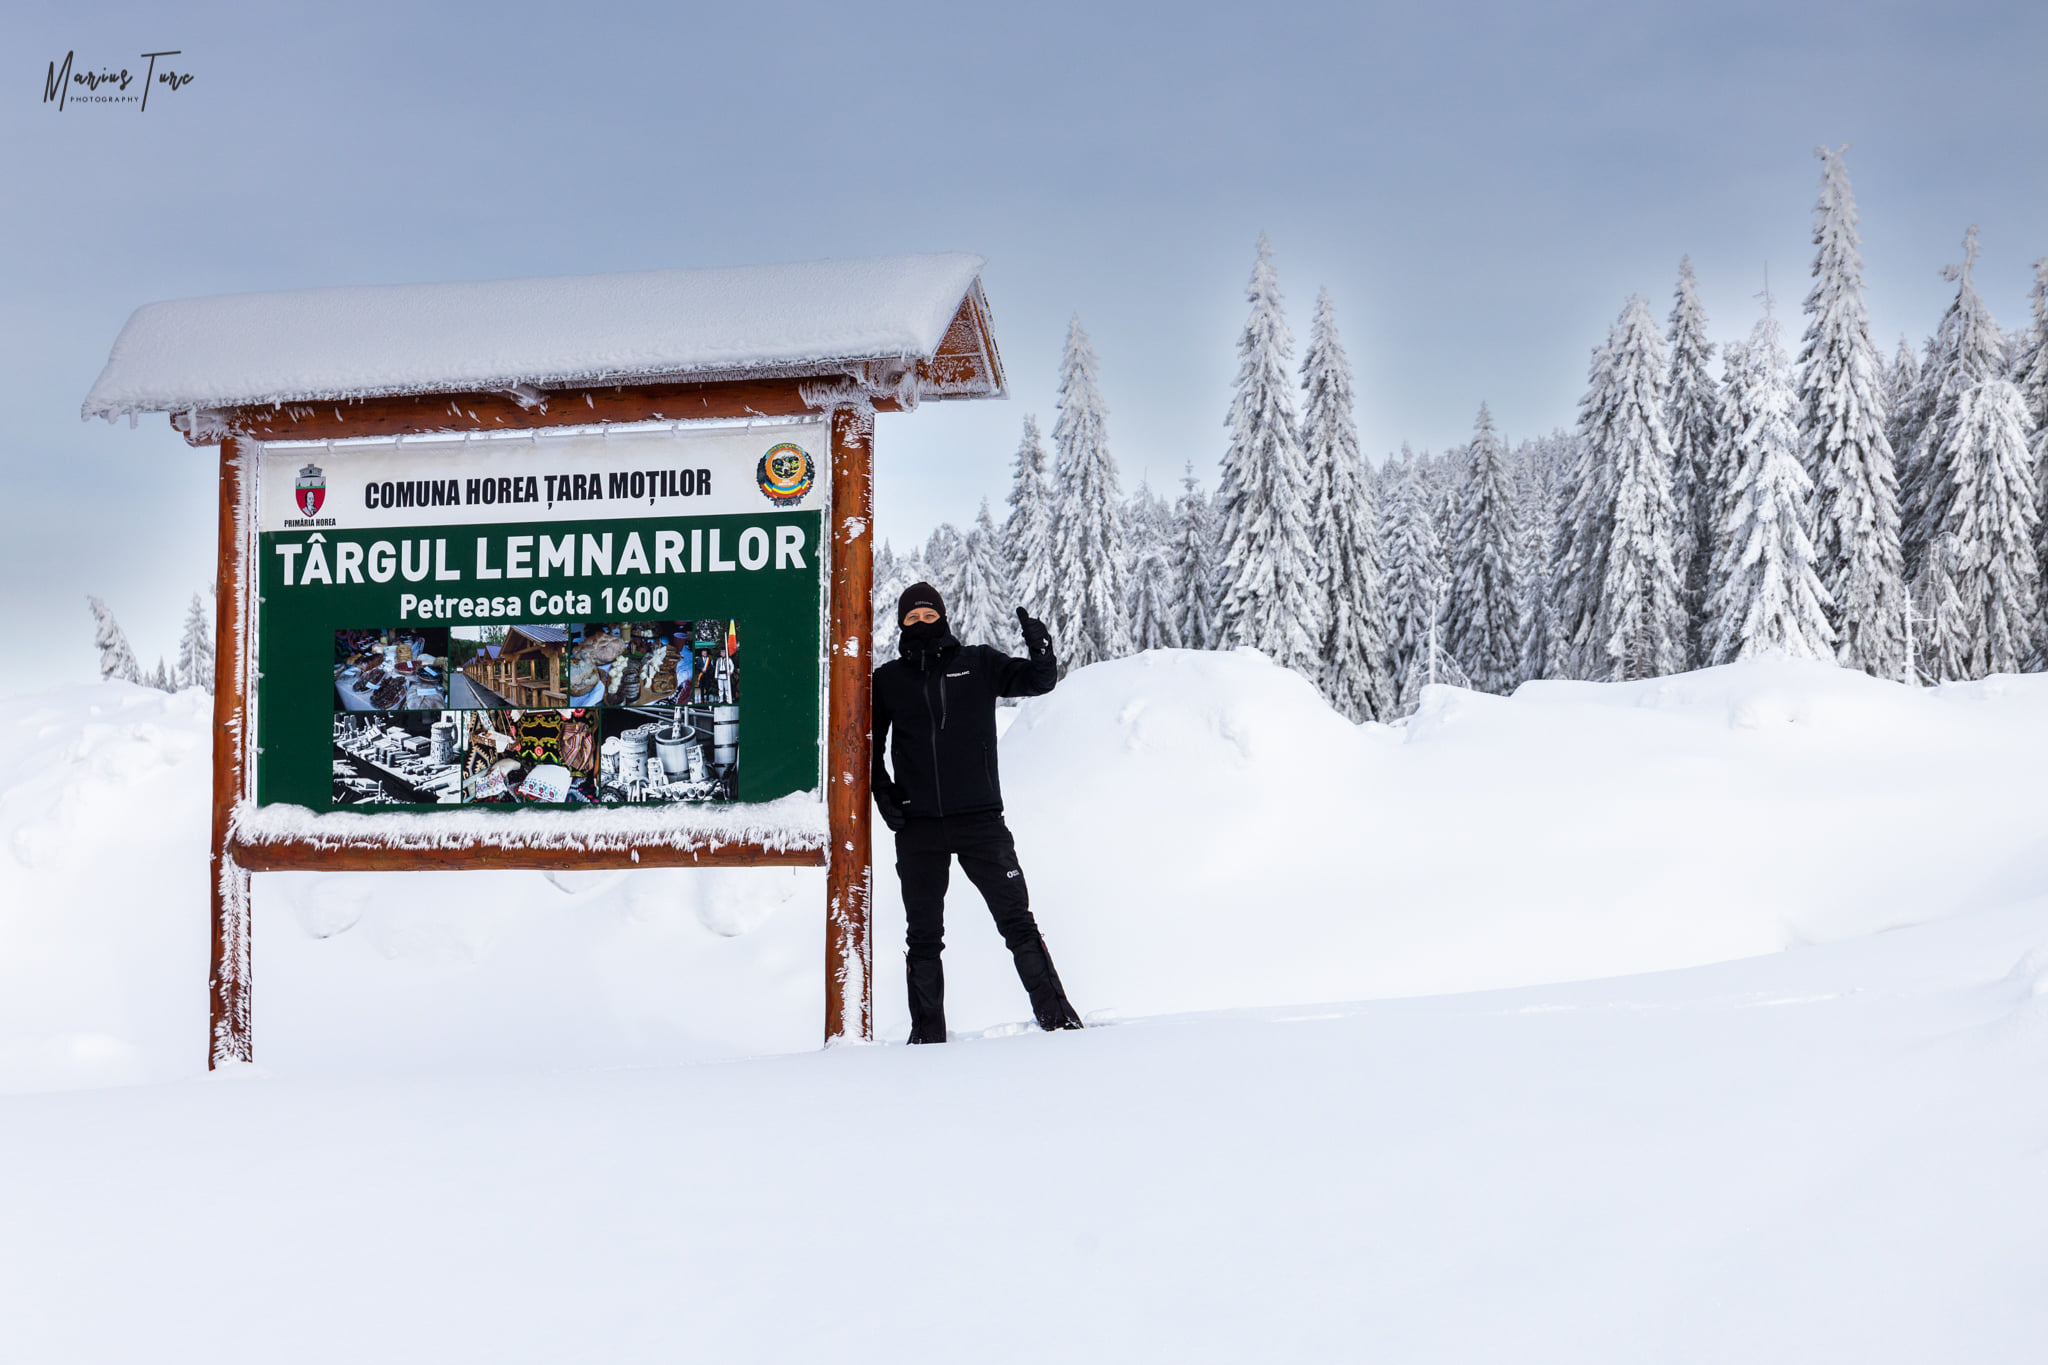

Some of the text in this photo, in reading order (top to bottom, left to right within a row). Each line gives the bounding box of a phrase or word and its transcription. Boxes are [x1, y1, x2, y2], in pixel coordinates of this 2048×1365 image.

[365, 468, 711, 510] COMUNA HOREA ȚARA MOȚILOR
[315, 518, 337, 527] HOREA
[275, 525, 807, 586] TÂRGUL LEMNARILOR
[400, 585, 669, 620] Petreasa Cota 1600
